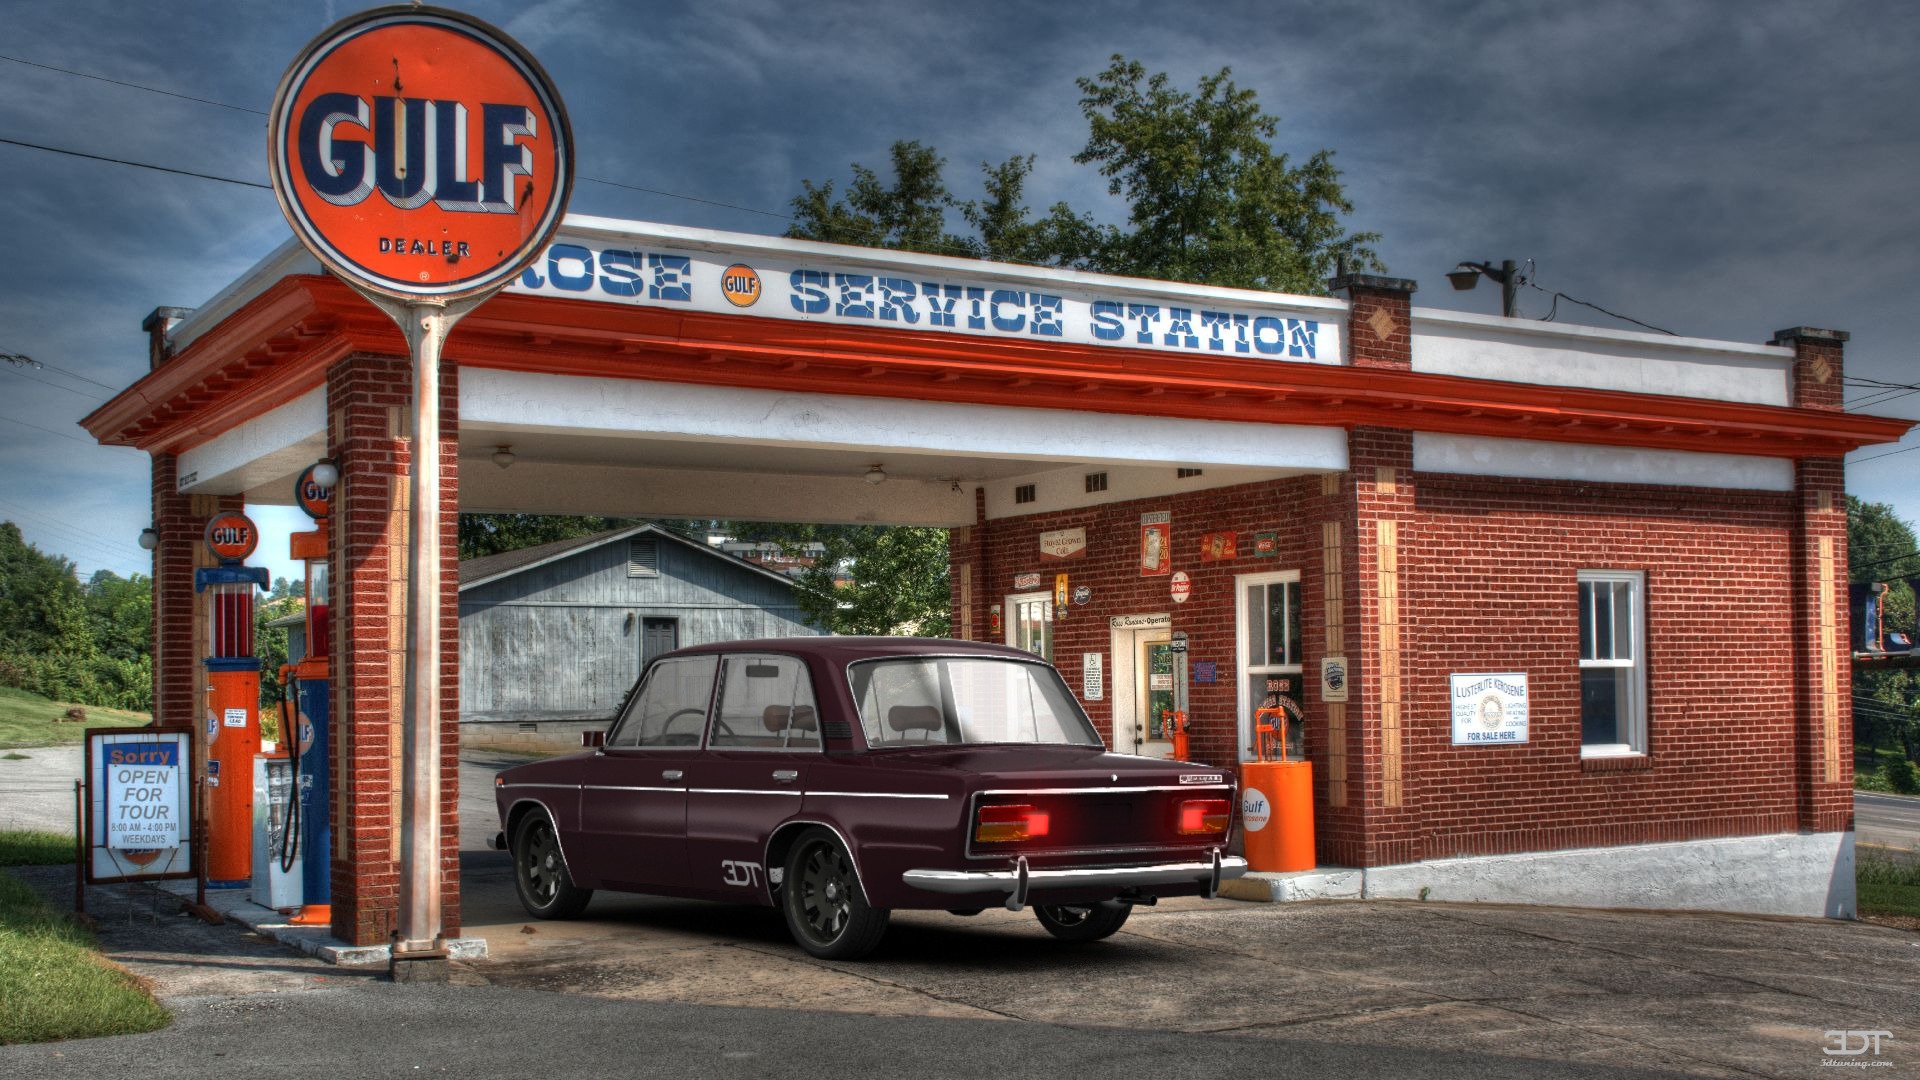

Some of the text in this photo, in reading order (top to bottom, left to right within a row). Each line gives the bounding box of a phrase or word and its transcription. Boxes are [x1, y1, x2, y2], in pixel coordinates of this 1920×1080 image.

[298, 92, 537, 215] GULF
[379, 237, 471, 257] DEALER
[724, 275, 756, 296] GULF
[789, 269, 1318, 359] SERVICE STATION
[211, 527, 248, 545] GULF
[1494, 678, 1525, 697] KEROSENE
[1467, 731, 1516, 741] FOR SALE HERE
[111, 750, 170, 765] Sorry
[118, 769, 169, 784] OPEN
[124, 787, 163, 802] FOR
[118, 805, 169, 820] TOUR
[1243, 800, 1264, 813] Gulf
[111, 823, 127, 832] 8:00
[129, 823, 141, 832] AM
[147, 822, 163, 832] 4:00
[165, 822, 177, 832] PM
[122, 834, 166, 844] WEEKDAYS
